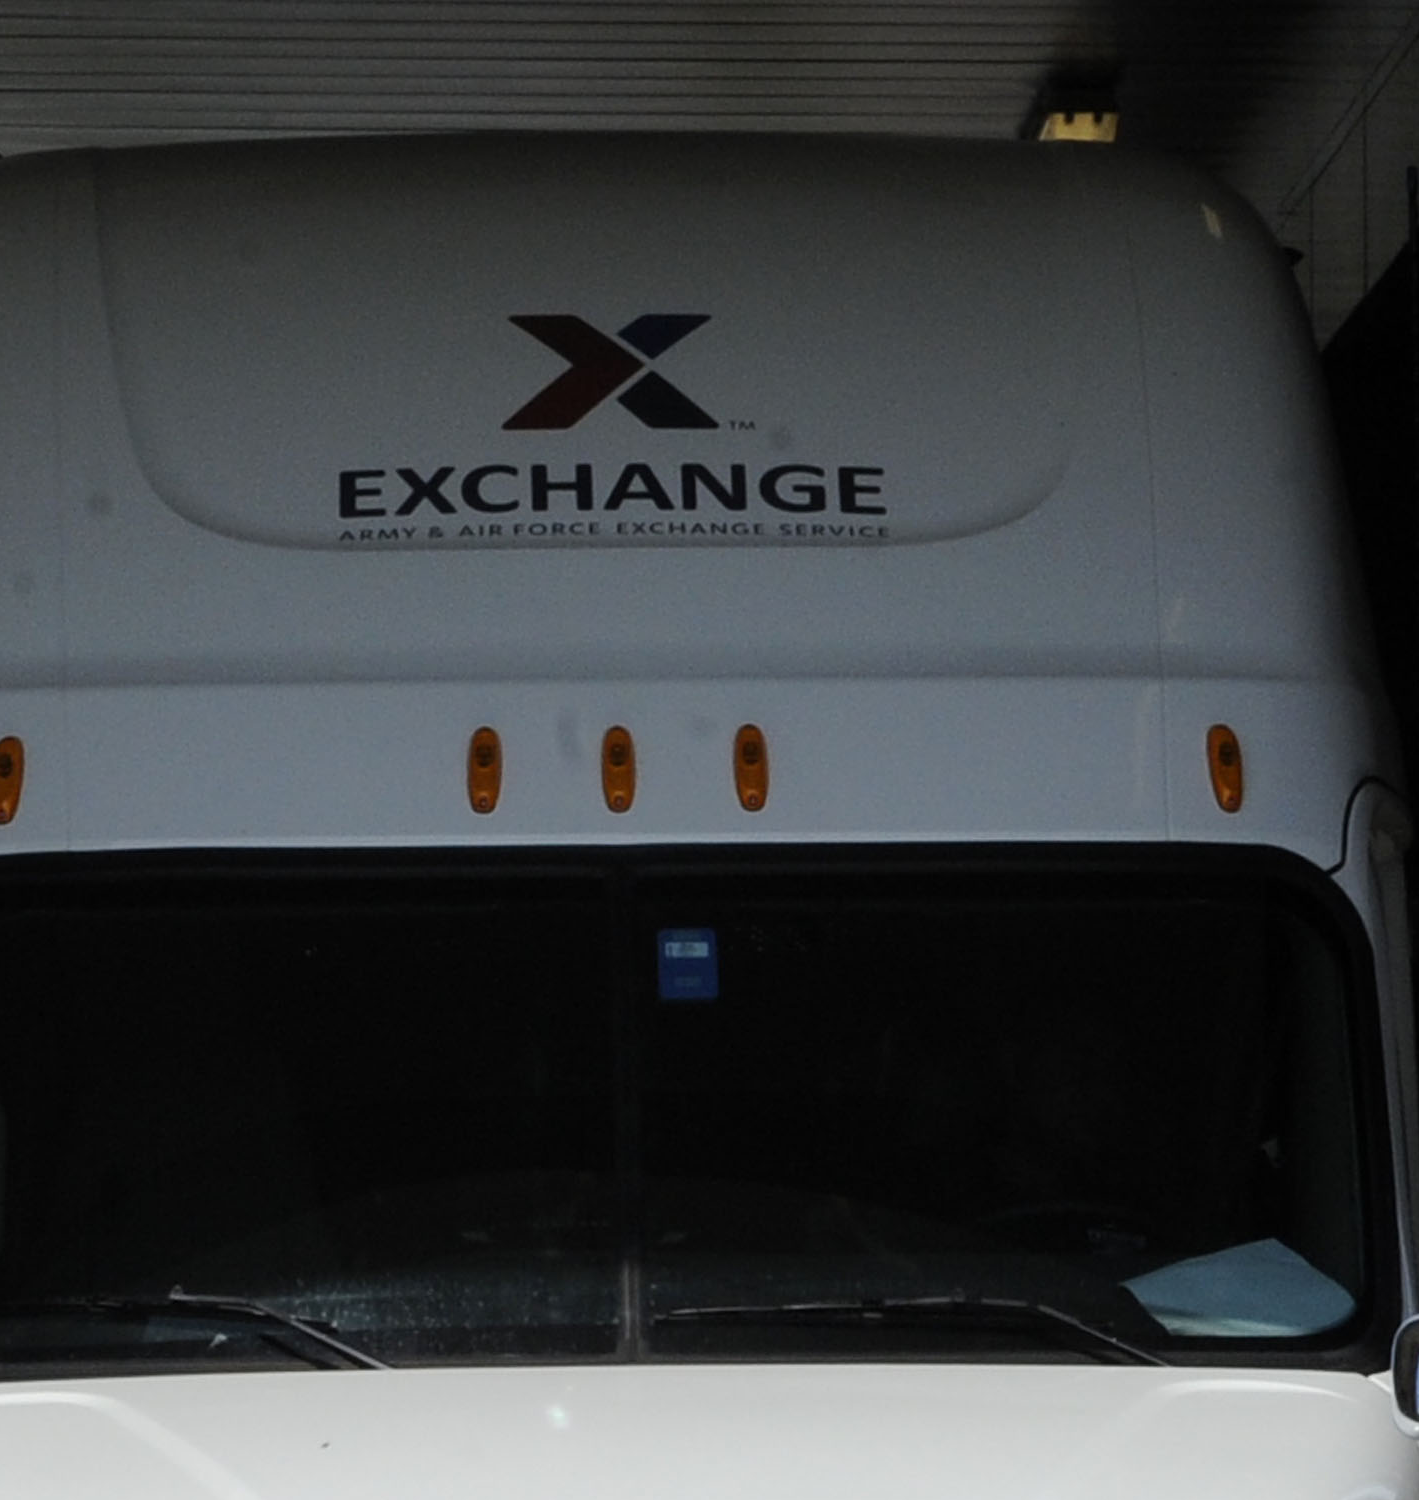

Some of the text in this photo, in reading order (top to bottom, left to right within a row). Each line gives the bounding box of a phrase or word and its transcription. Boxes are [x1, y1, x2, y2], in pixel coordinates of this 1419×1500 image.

[338, 463, 887, 519] EXCHANGE
[340, 522, 890, 541] ARMY & AIR FORCE EXCHANGE SERVICE
